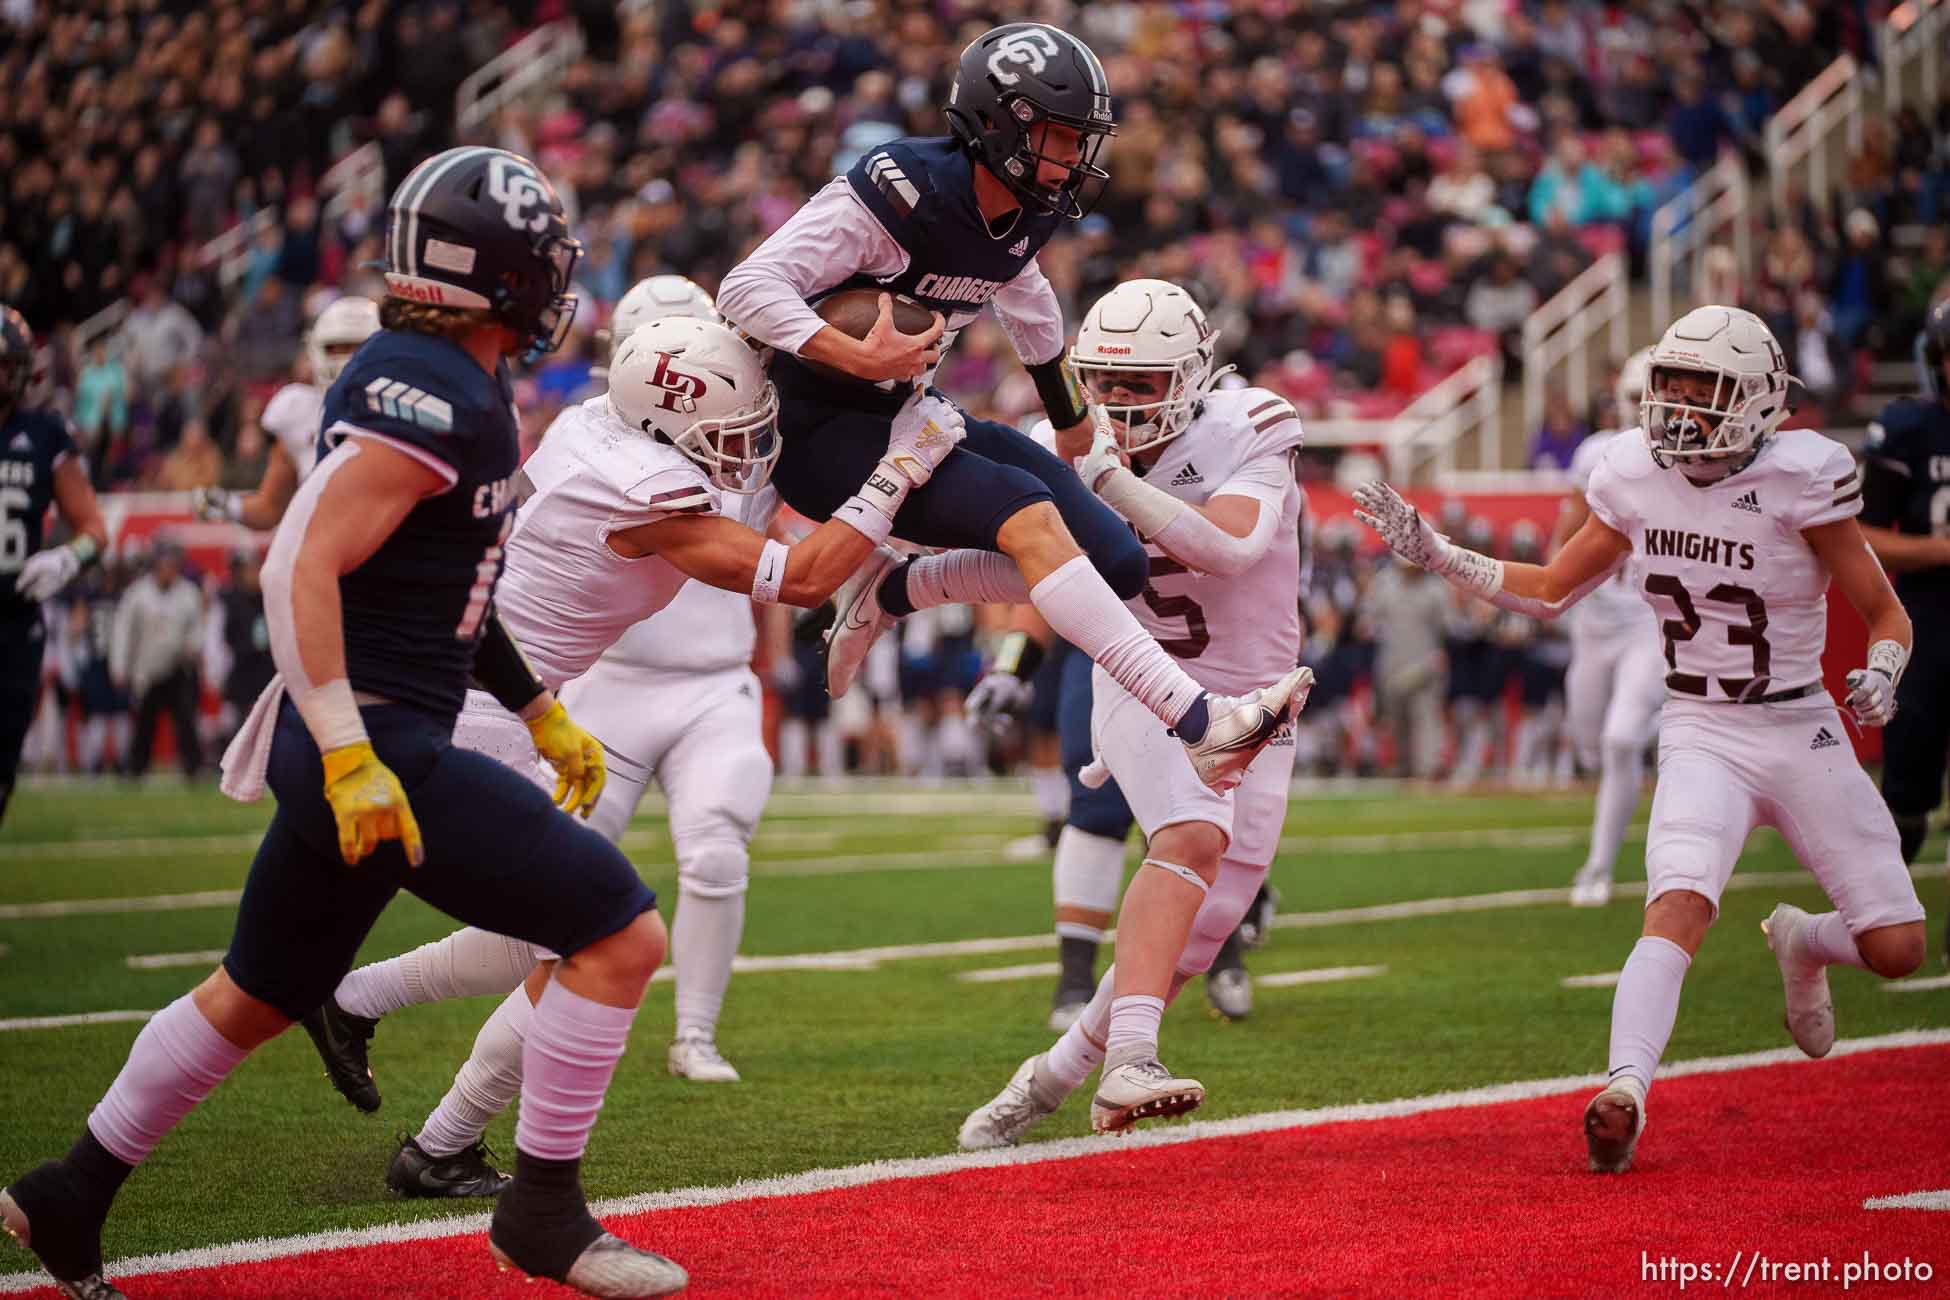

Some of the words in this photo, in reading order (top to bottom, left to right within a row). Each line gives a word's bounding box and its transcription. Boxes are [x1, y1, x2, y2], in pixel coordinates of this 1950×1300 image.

[1097, 344, 1131, 355] Riddell
[1171, 475, 1205, 487] adidas
[1730, 500, 1762, 514] adidas
[1644, 528, 1755, 571] KNIGHTS
[1644, 573, 1771, 697] 23
